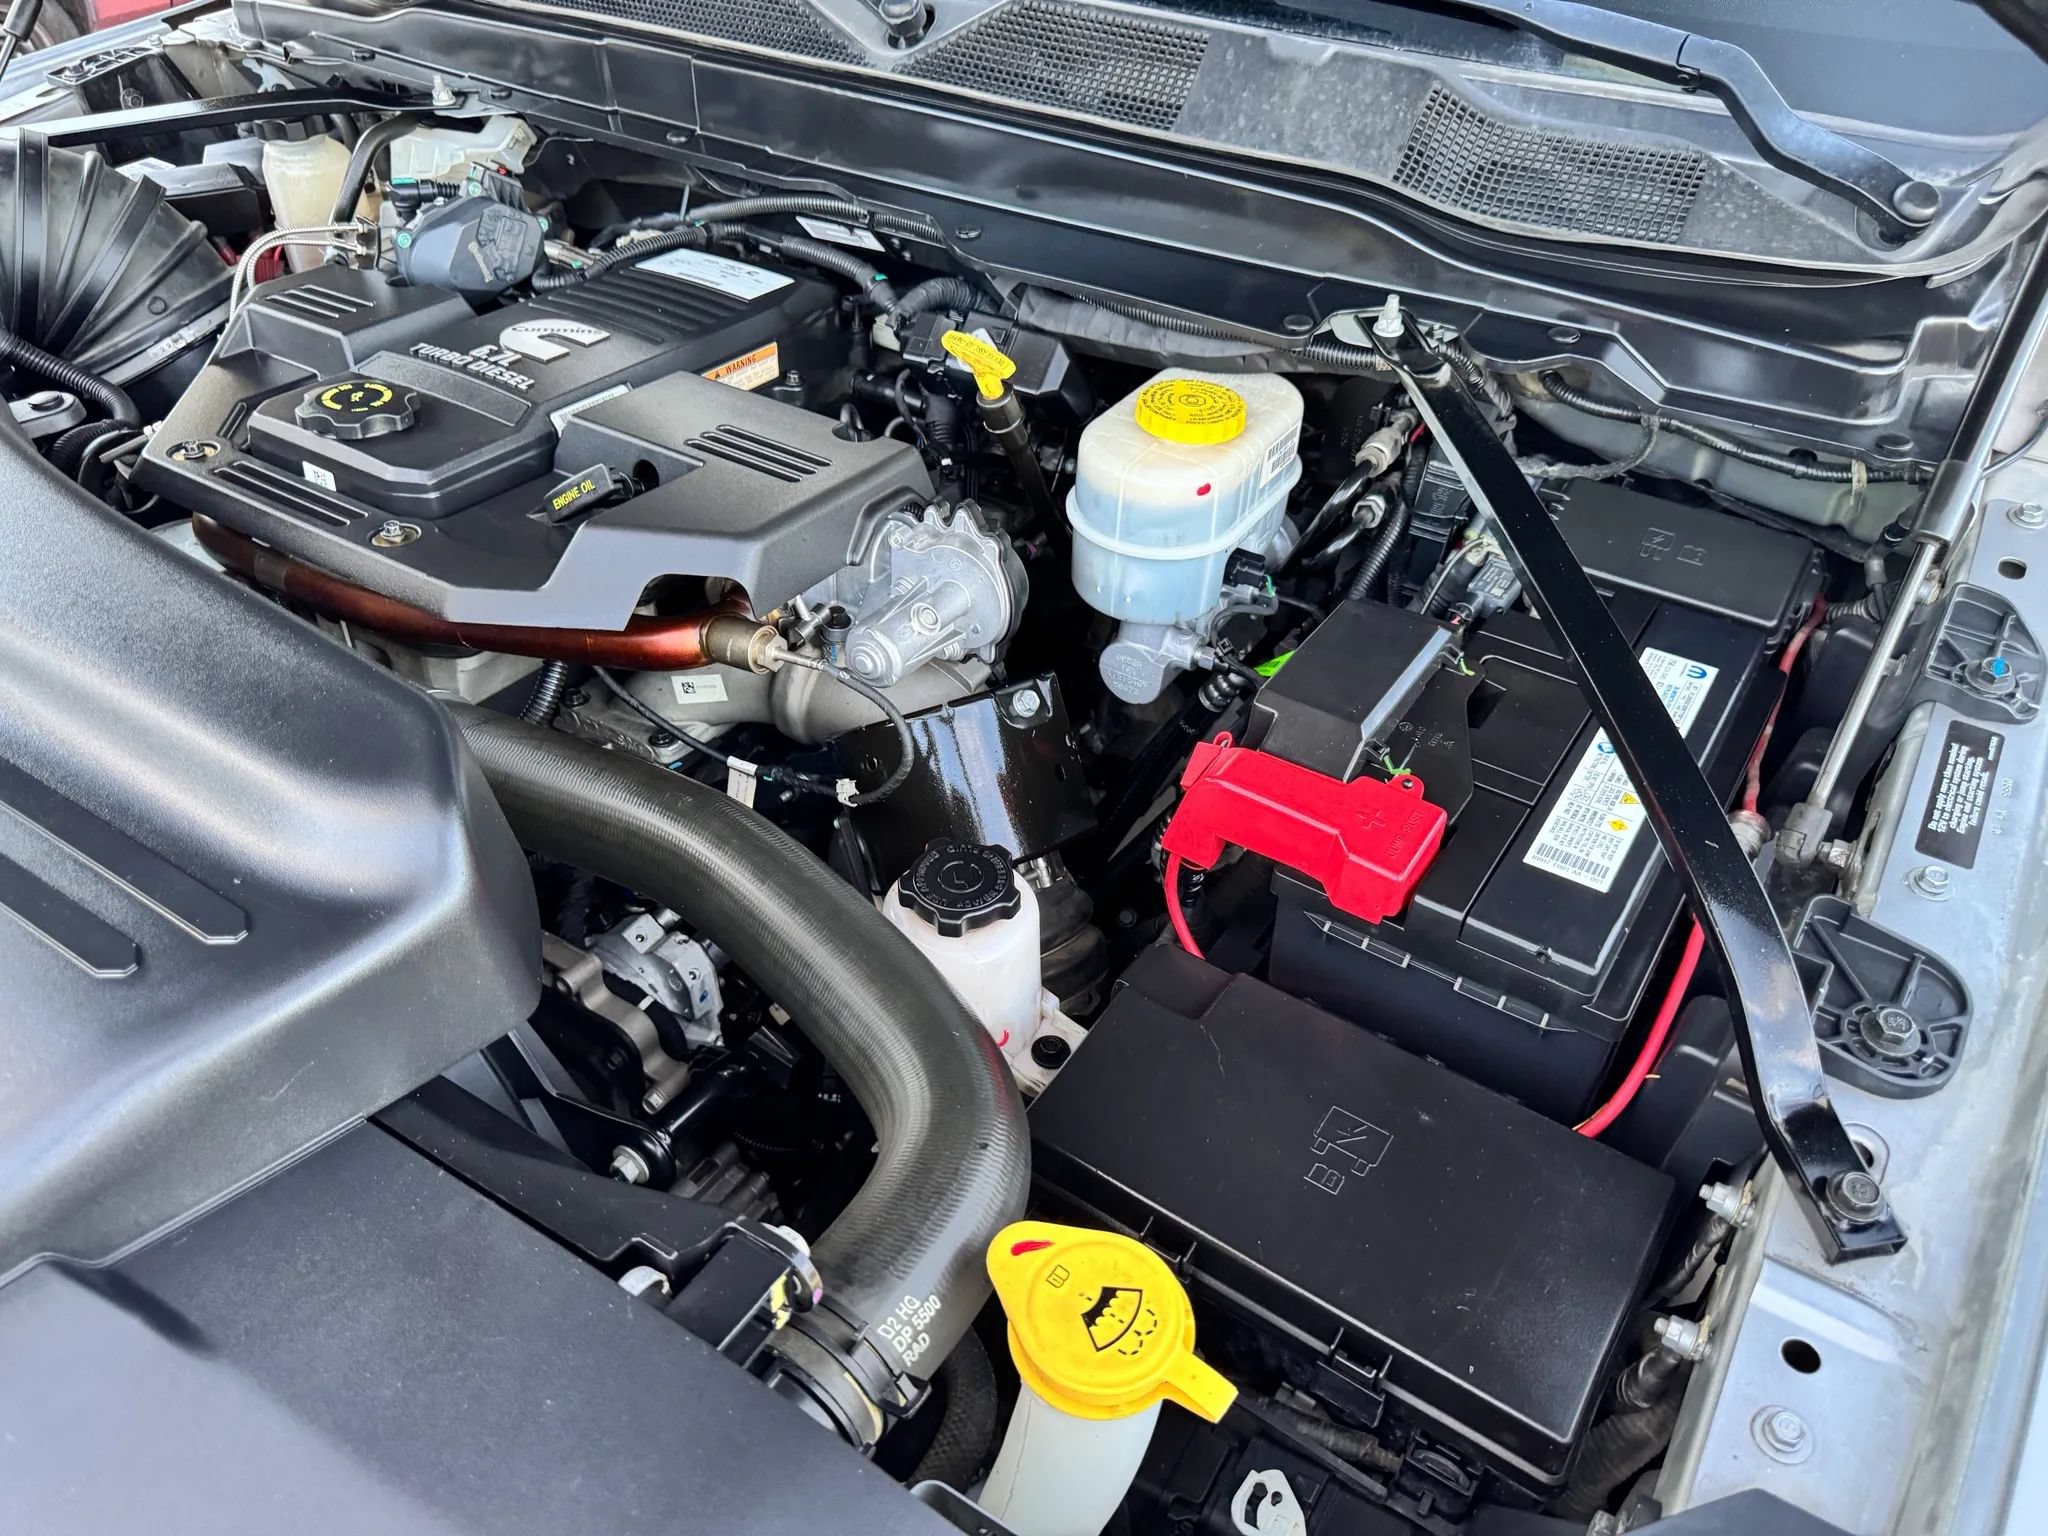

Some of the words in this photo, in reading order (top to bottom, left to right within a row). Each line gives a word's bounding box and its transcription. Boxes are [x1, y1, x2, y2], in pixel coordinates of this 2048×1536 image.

[511, 325, 605, 335] Cummins
[469, 344, 523, 368] 6.7L
[725, 354, 757, 375] WARNING
[409, 342, 475, 368] TURBO
[467, 358, 536, 392] DIESEL
[552, 486, 581, 511] ENGINE
[580, 479, 596, 494] OIL
[1956, 744, 1969, 763] during
[1942, 764, 1953, 778] than
[1951, 763, 1964, 784] system
[1974, 757, 1985, 778] system
[1940, 778, 1949, 793] more
[1965, 777, 1979, 801] starting
[1934, 792, 1946, 809] apply
[1943, 783, 1957, 811] electrical
[1948, 802, 1963, 829] charging
[1958, 780, 1969, 795] jump
[1962, 801, 1972, 813] and
[1974, 790, 1984, 805] could
[1928, 819, 1938, 830] Do
[1931, 808, 1941, 820] not
[1941, 811, 1950, 819] to
[1957, 813, 1970, 834] Engine
[1969, 805, 1980, 825] failure
[1937, 818, 1948, 832] 12V
[877, 1316, 902, 1340] D2
[892, 1326, 913, 1354] DP
[911, 1294, 942, 1330] 5500
[902, 1332, 931, 1367] RAD
